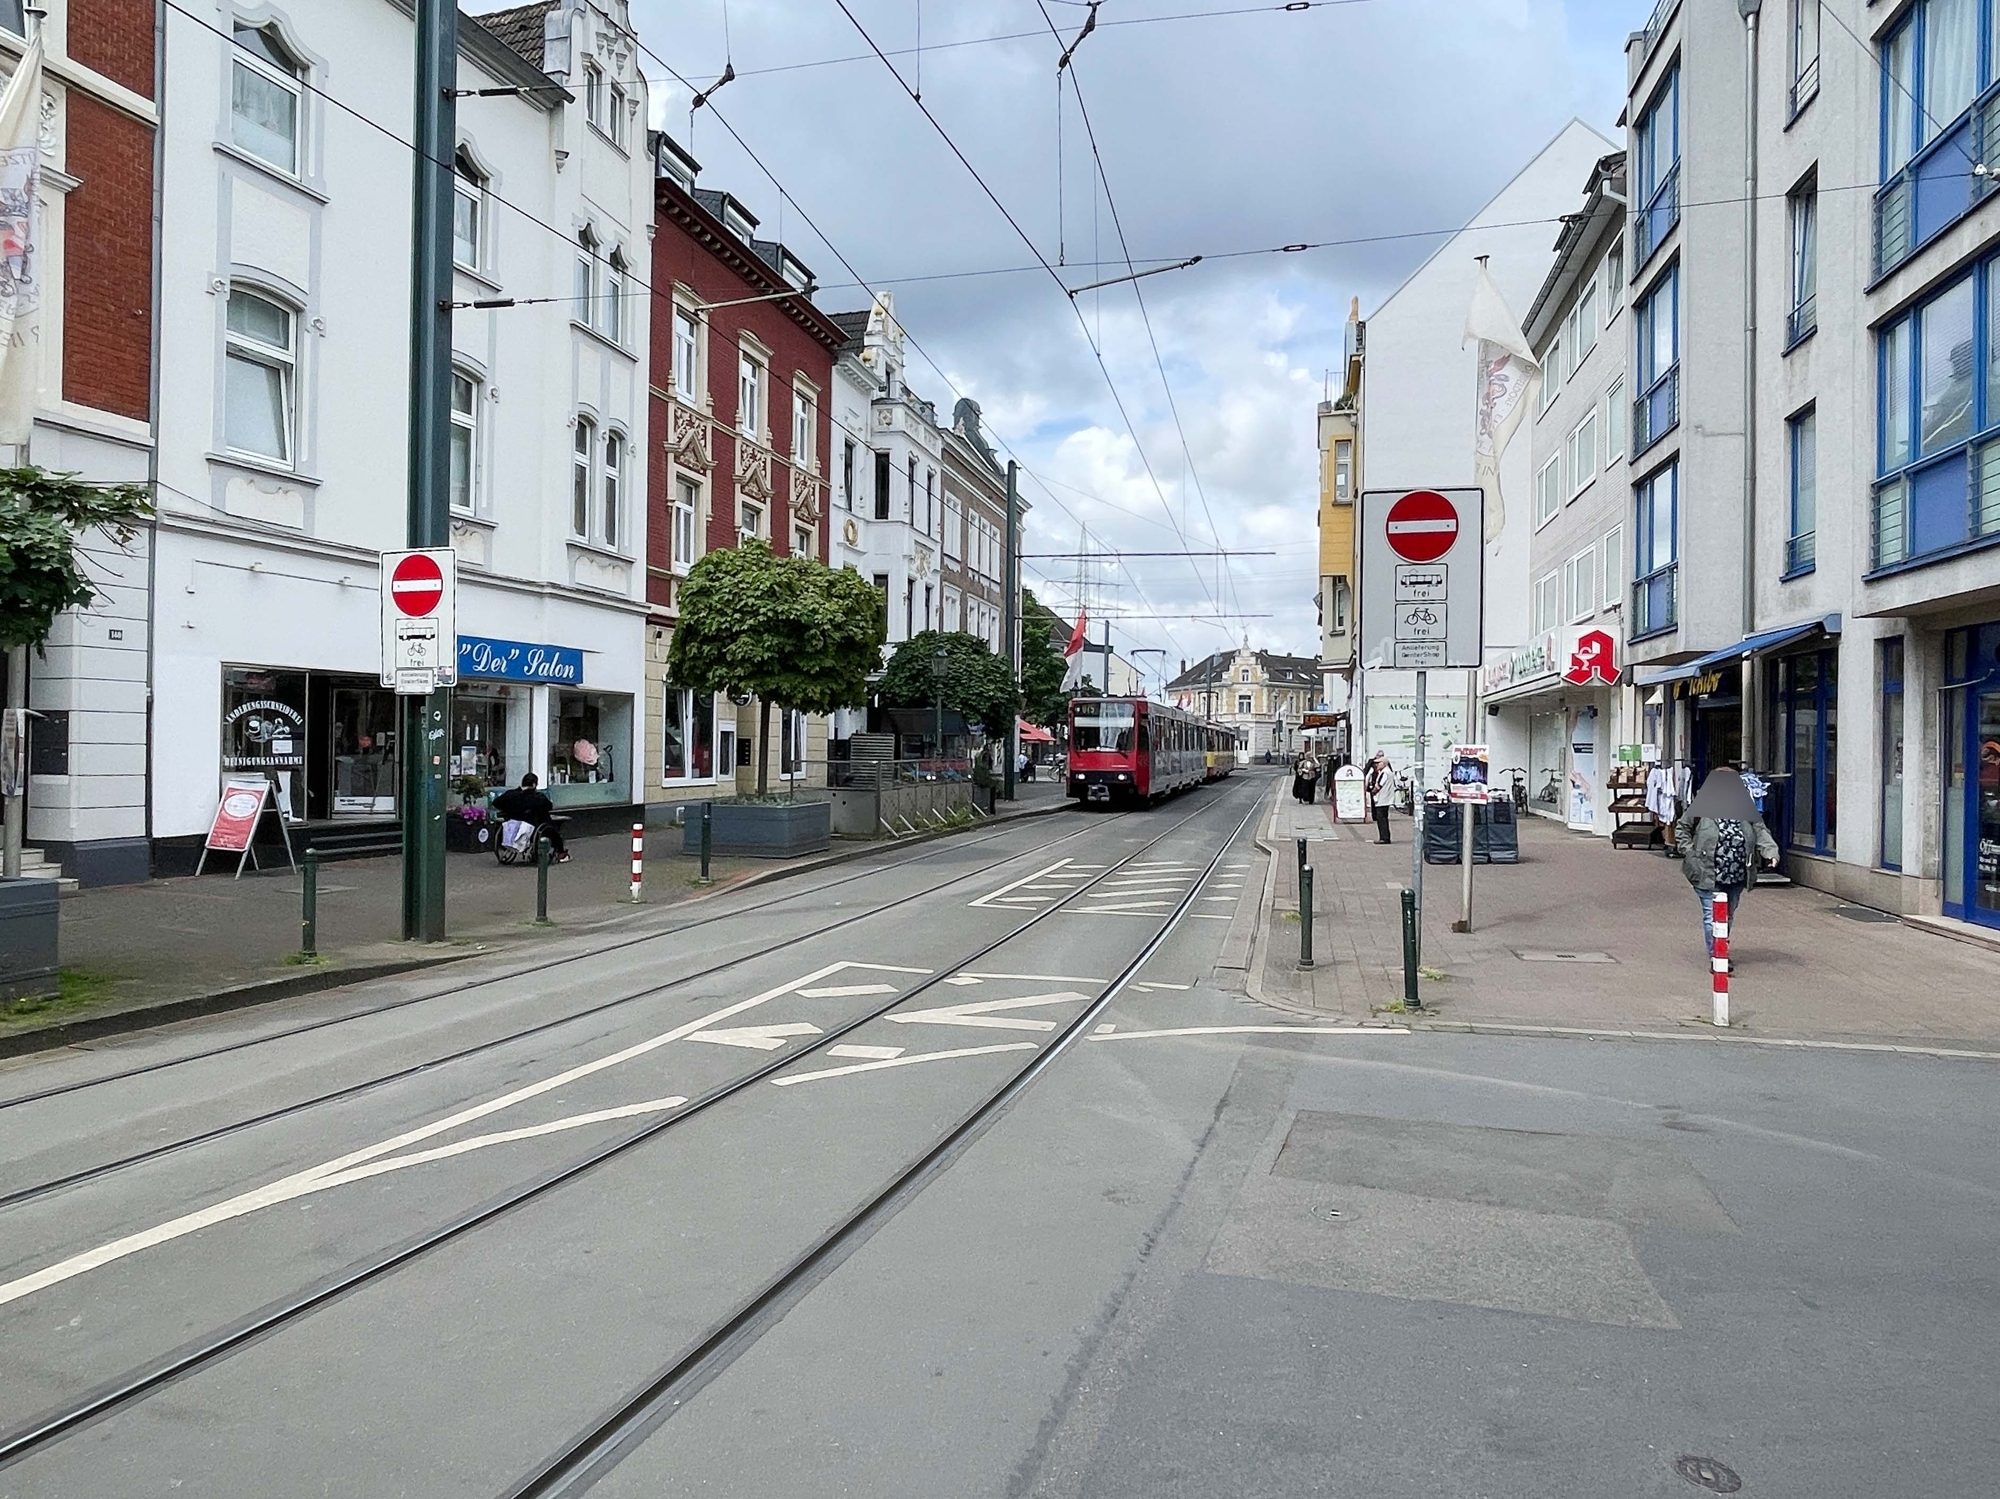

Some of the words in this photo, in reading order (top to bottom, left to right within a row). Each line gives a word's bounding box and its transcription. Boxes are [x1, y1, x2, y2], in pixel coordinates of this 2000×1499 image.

[1413, 590, 1430, 598] frei
[1413, 628, 1430, 636] frei
[410, 659, 425, 667] frei
[523, 648, 575, 679] Salon
[1388, 702, 1430, 711] AUGUSA
[224, 756, 304, 767] REINIGUNGSANNAHME
